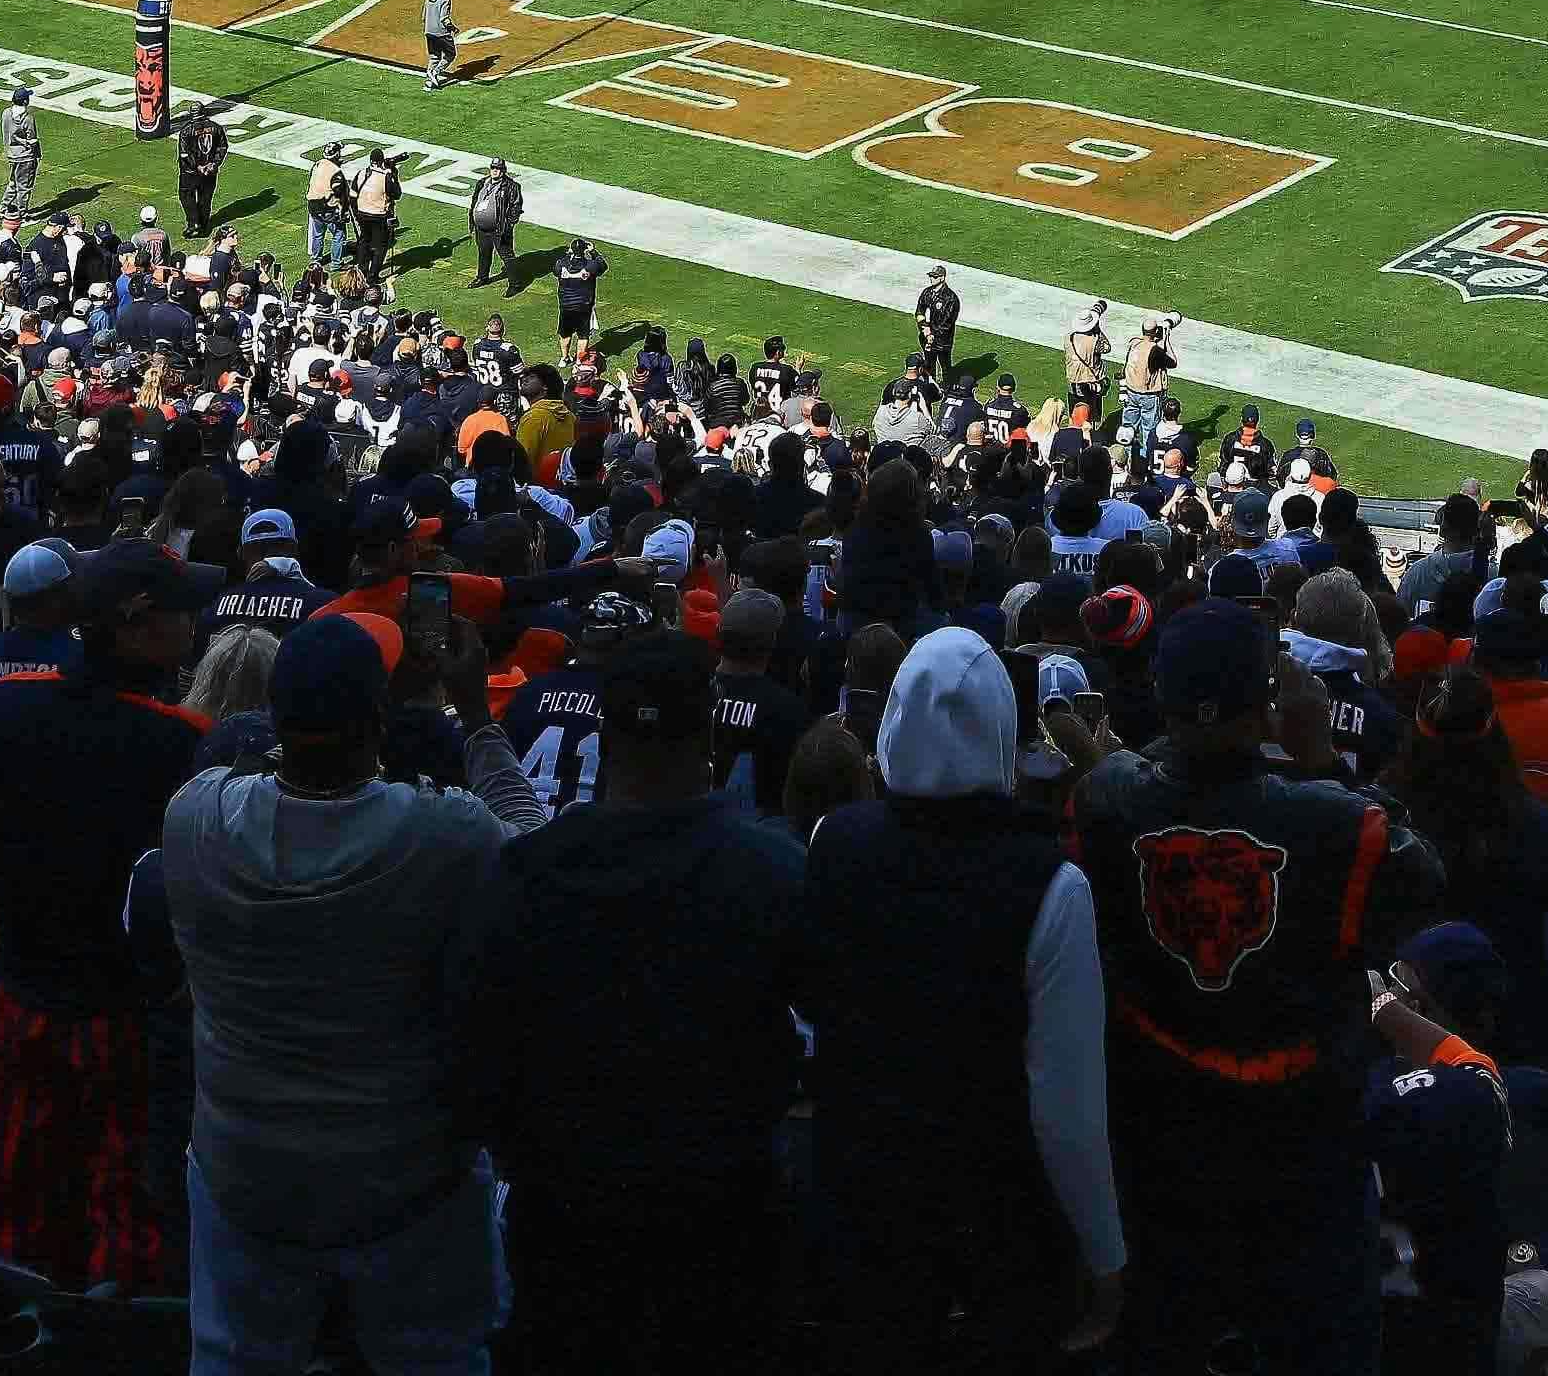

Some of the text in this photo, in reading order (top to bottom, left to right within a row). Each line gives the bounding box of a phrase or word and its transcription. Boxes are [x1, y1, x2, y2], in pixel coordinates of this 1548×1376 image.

[475, 358, 503, 385] 58
[756, 382, 782, 409] 34
[734, 424, 769, 451] 52
[986, 417, 1011, 442] 50
[216, 595, 304, 620] URLACHER
[519, 725, 601, 819] 41
